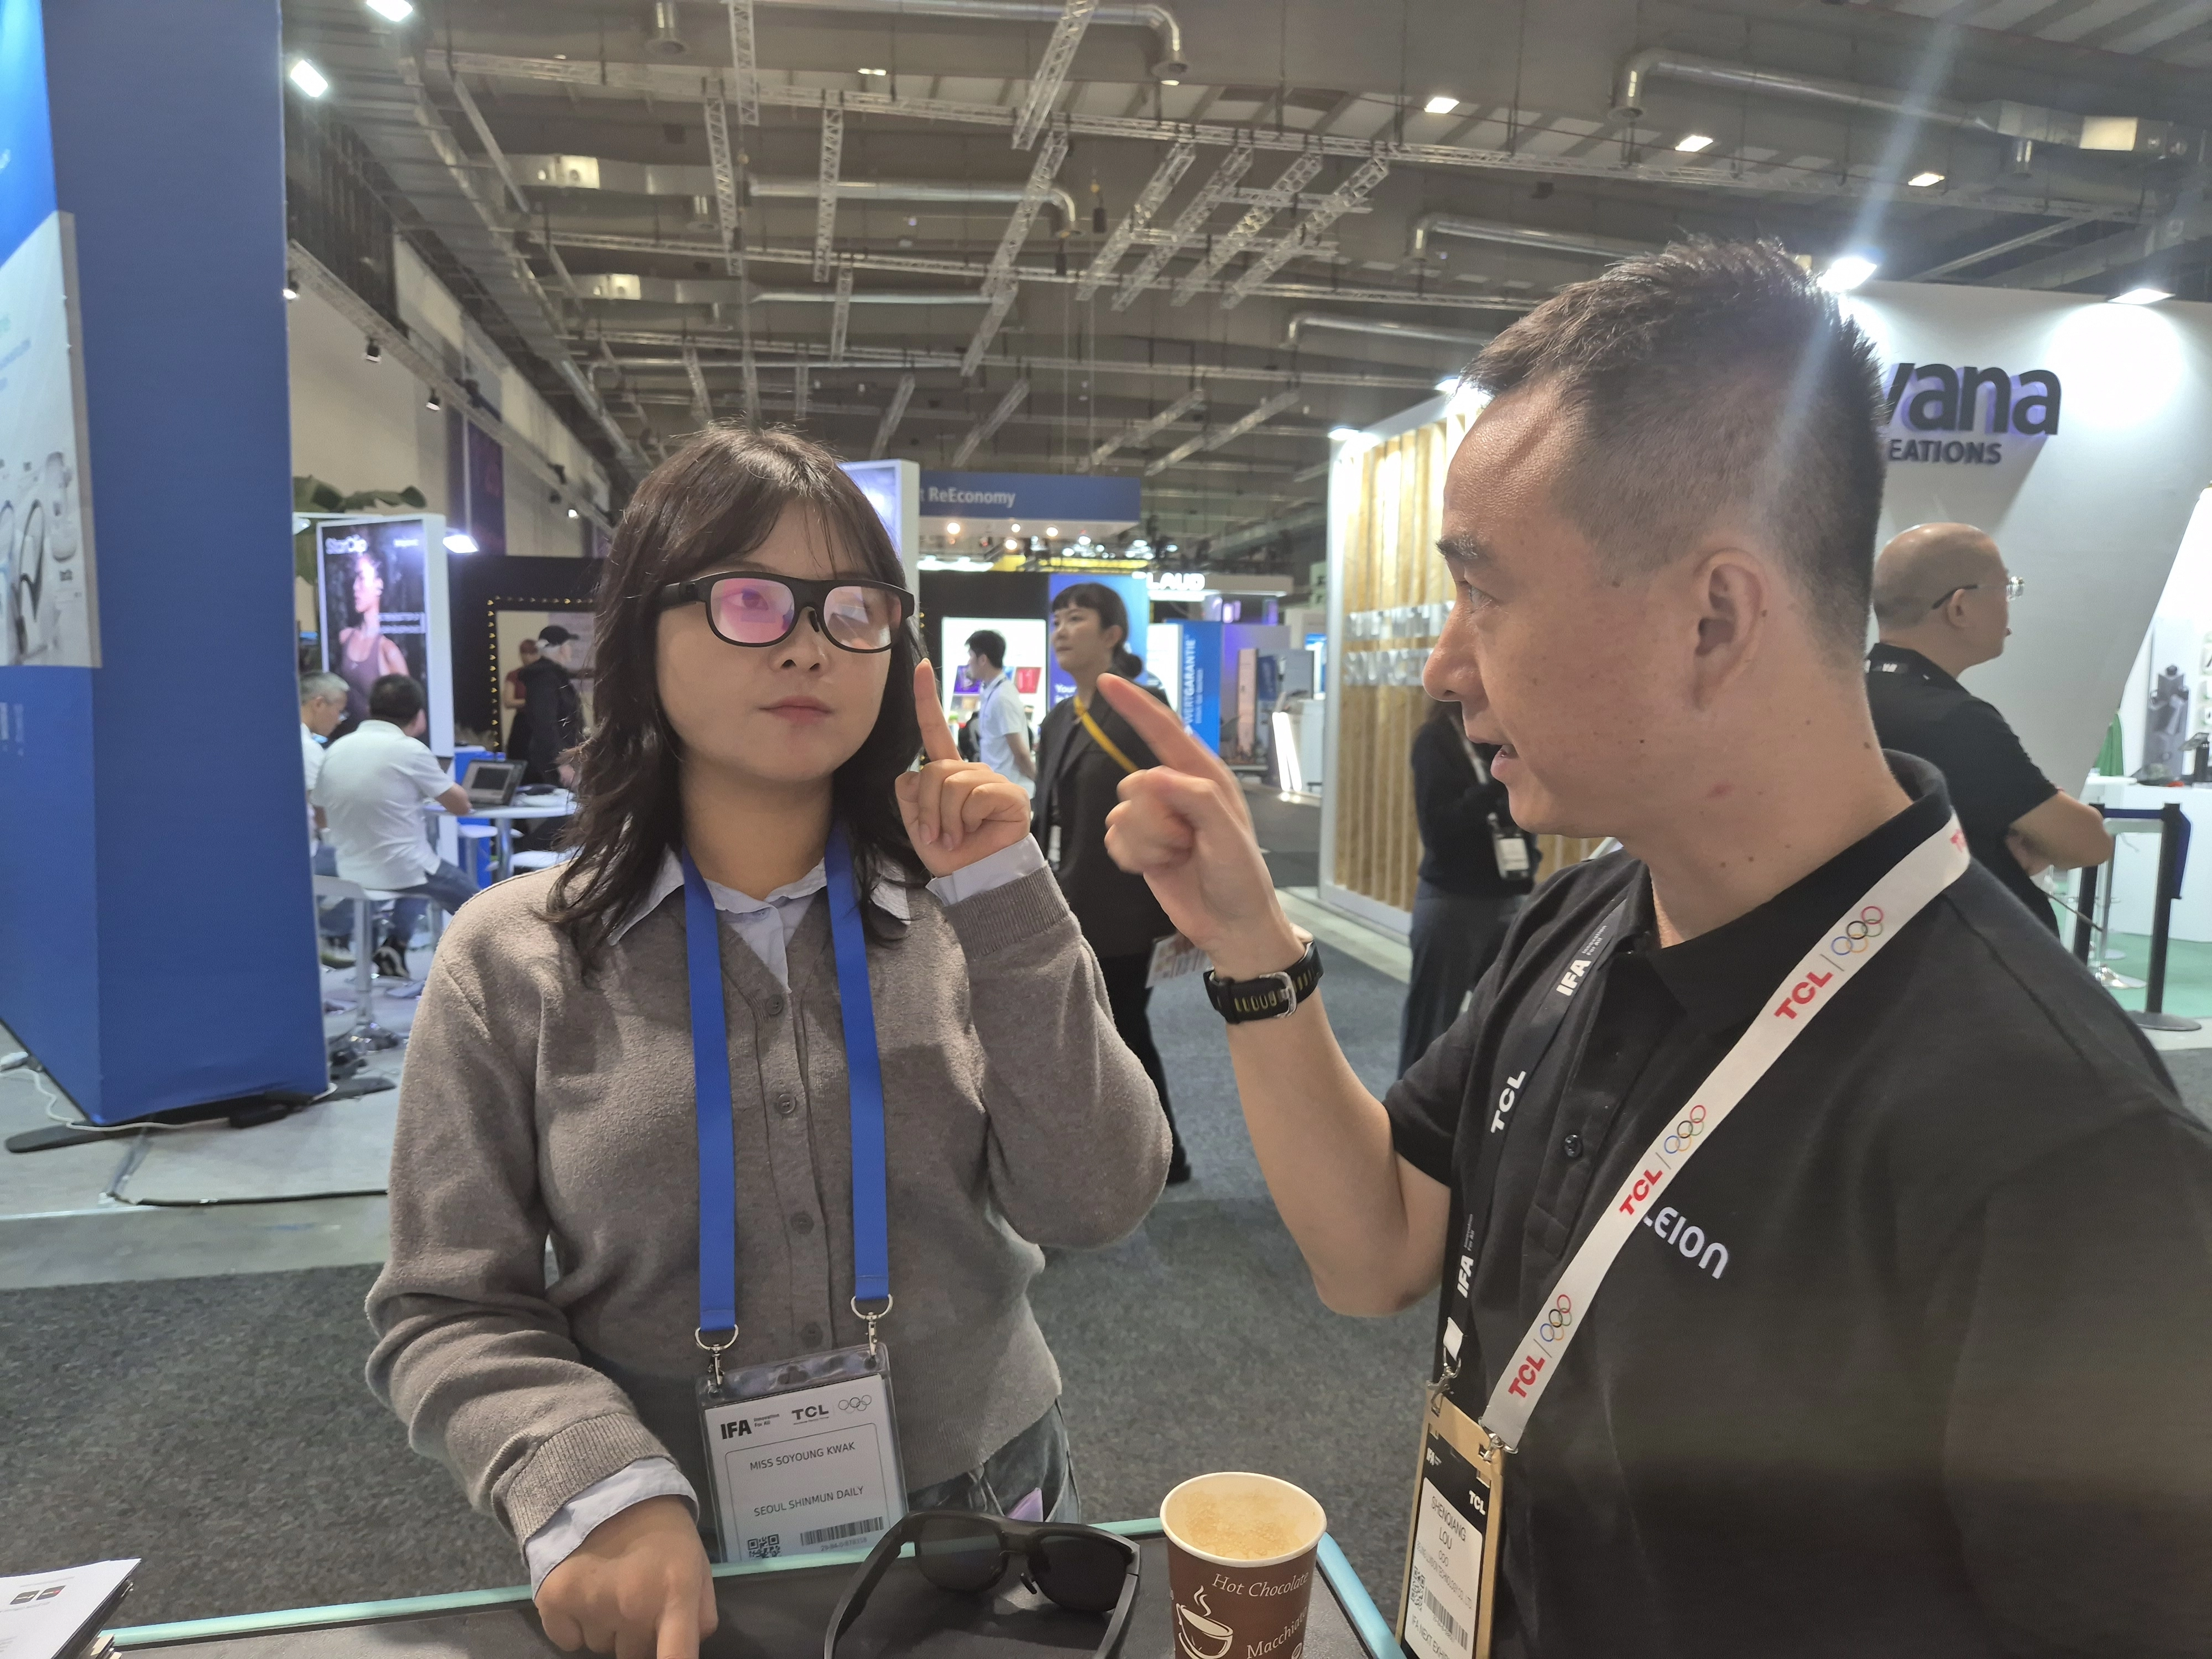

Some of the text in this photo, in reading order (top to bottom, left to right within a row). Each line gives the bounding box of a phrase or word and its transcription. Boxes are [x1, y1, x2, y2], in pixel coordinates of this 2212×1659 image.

[1888, 439, 2002, 465] EATIONS
[928, 487, 1015, 509] ReEconomy
[1556, 959, 1592, 996] IFA
[1774, 968, 1833, 1021] TCL
[1490, 1071, 1526, 1134] TCL
[1619, 1168, 1663, 1215] TCL
[1457, 1255, 1474, 1298] IFA
[1507, 1355, 1546, 1399] TCL
[791, 1405, 829, 1420] TCL
[720, 1419, 752, 1440] IFA
[750, 1441, 855, 1471] MISS SOYOUNG KWAK
[754, 1485, 864, 1517] SEOUL SHINMUN DAILY
[1469, 1490, 1486, 1515] TCL
[1431, 1495, 1466, 1542] SHENQIANG
[1439, 1526, 1453, 1550] LOU
[1211, 1572, 1310, 1597] Hot Chocolate
